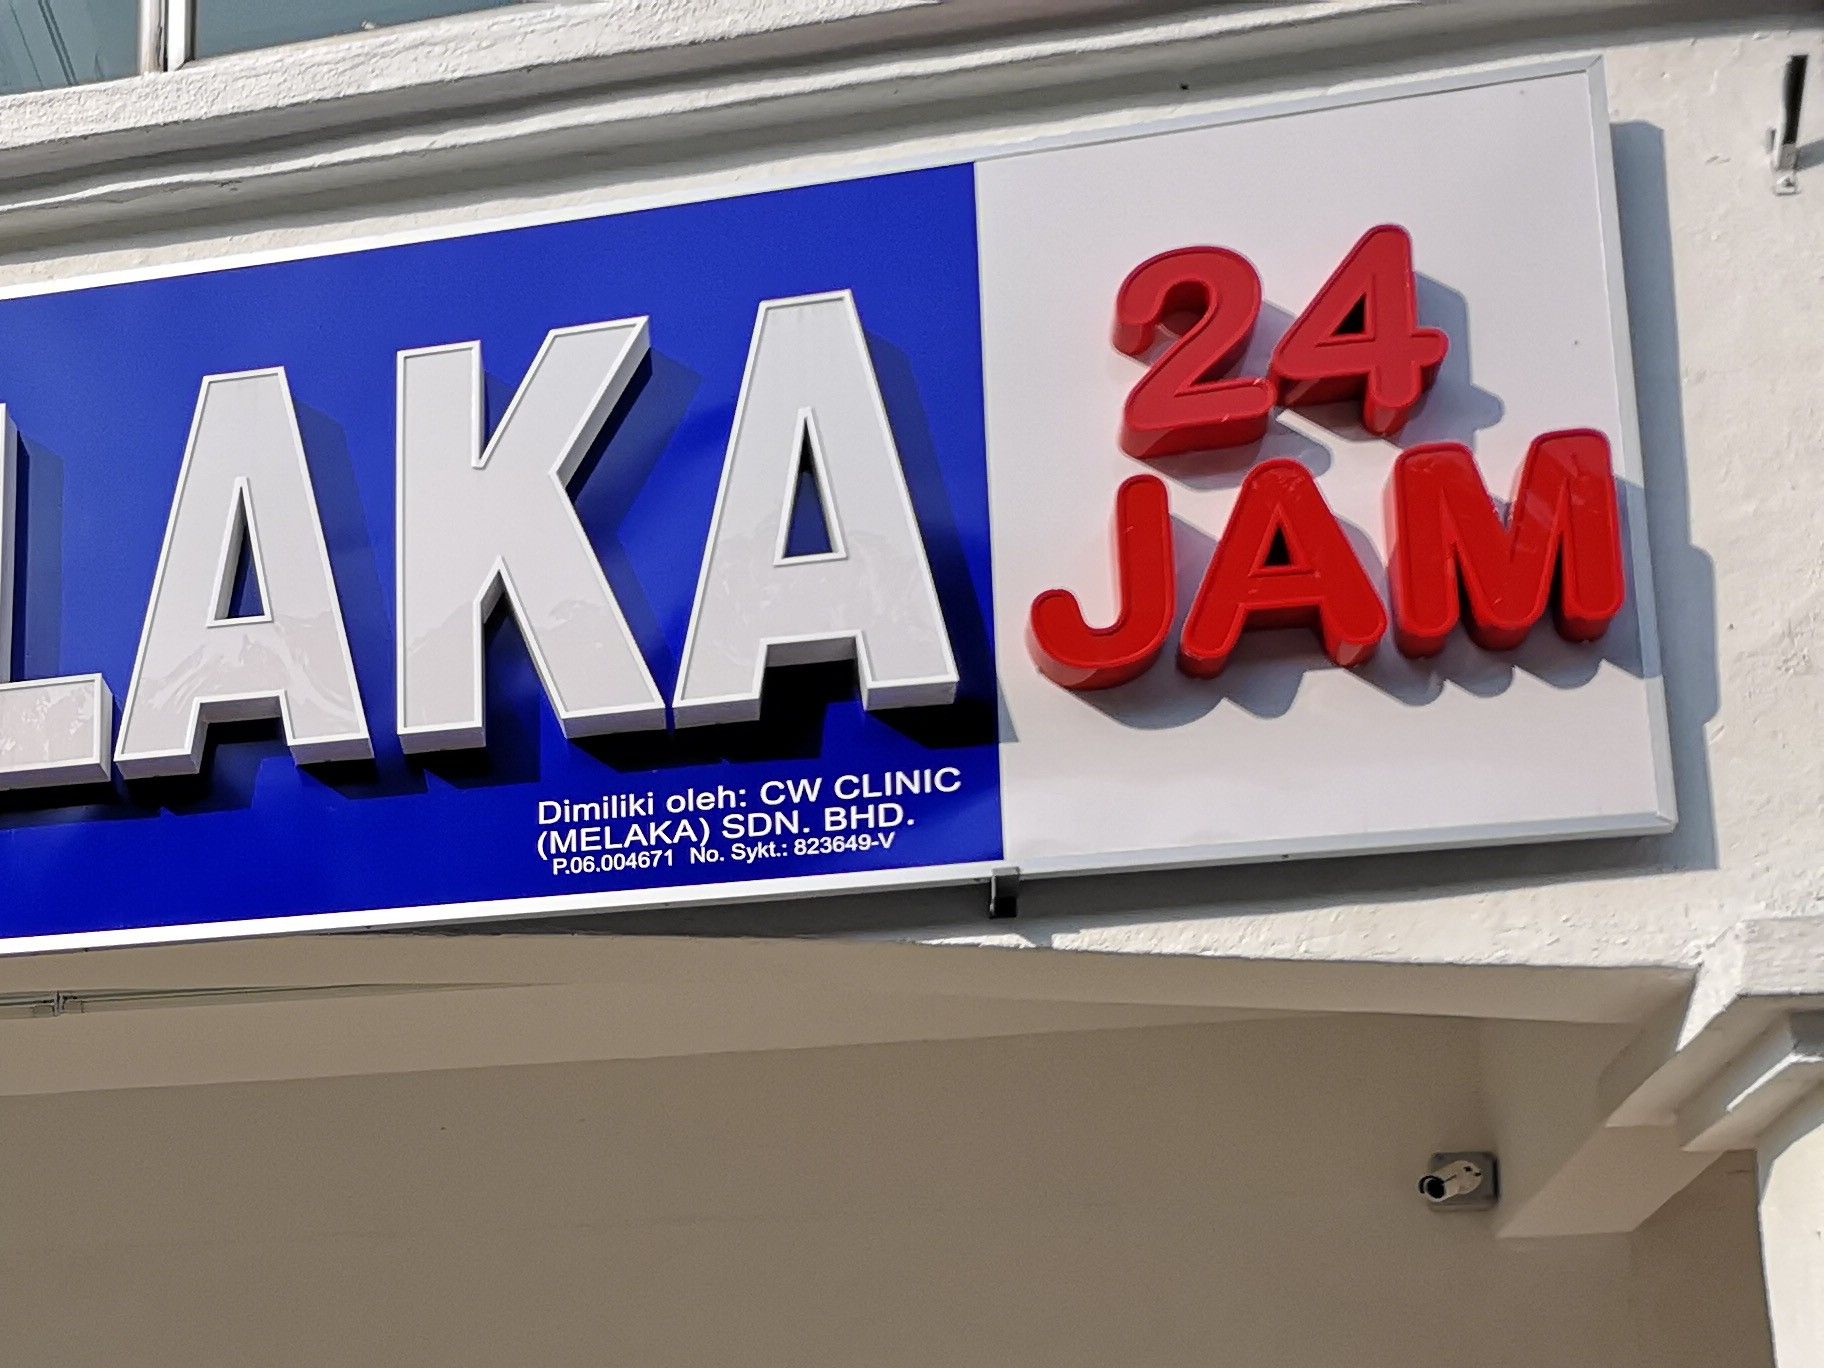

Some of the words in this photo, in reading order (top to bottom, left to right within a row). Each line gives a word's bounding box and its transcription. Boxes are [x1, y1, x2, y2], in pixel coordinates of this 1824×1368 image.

[1112, 223, 1449, 459] 24
[1026, 427, 1626, 690] JAM
[537, 791, 654, 825] Dimiliki
[665, 784, 747, 814] oleh:
[759, 777, 823, 806] CW
[833, 766, 962, 800] CLINIC
[537, 817, 710, 861] (MELAKA)
[721, 809, 810, 839] SDN.
[824, 802, 915, 832] BHD.
[552, 848, 673, 876] P.06.004671
[689, 845, 725, 864] No.
[730, 840, 788, 864] Sykt.:
[793, 831, 896, 856] 823649-V
